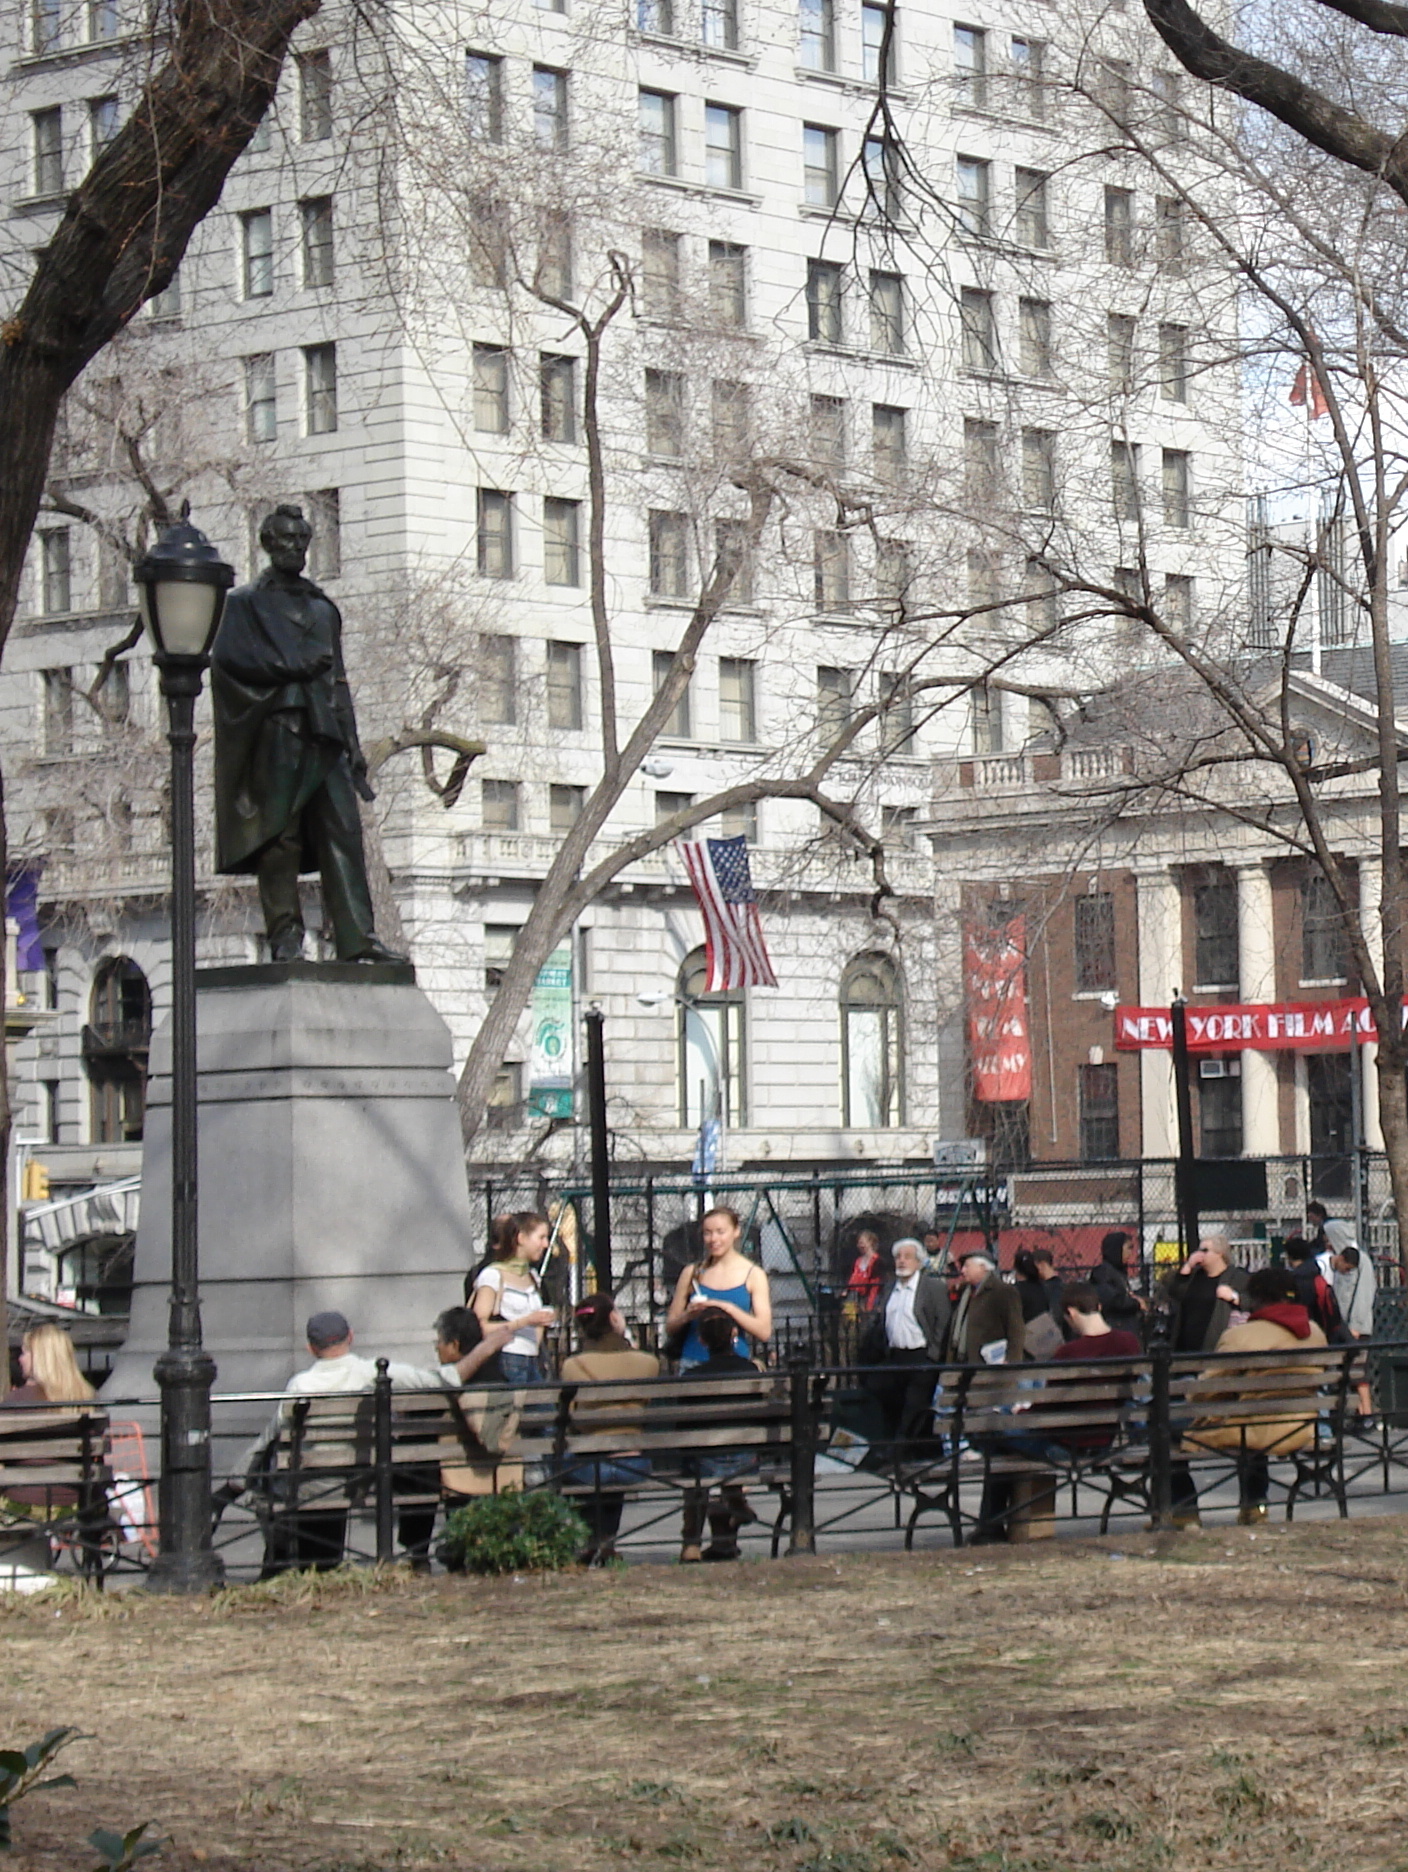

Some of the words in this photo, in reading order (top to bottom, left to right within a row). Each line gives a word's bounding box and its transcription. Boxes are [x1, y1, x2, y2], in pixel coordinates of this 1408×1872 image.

[1121, 1015, 1175, 1042] NEW
[1189, 1013, 1262, 1041] YORK
[1267, 1010, 1335, 1039] FILM
